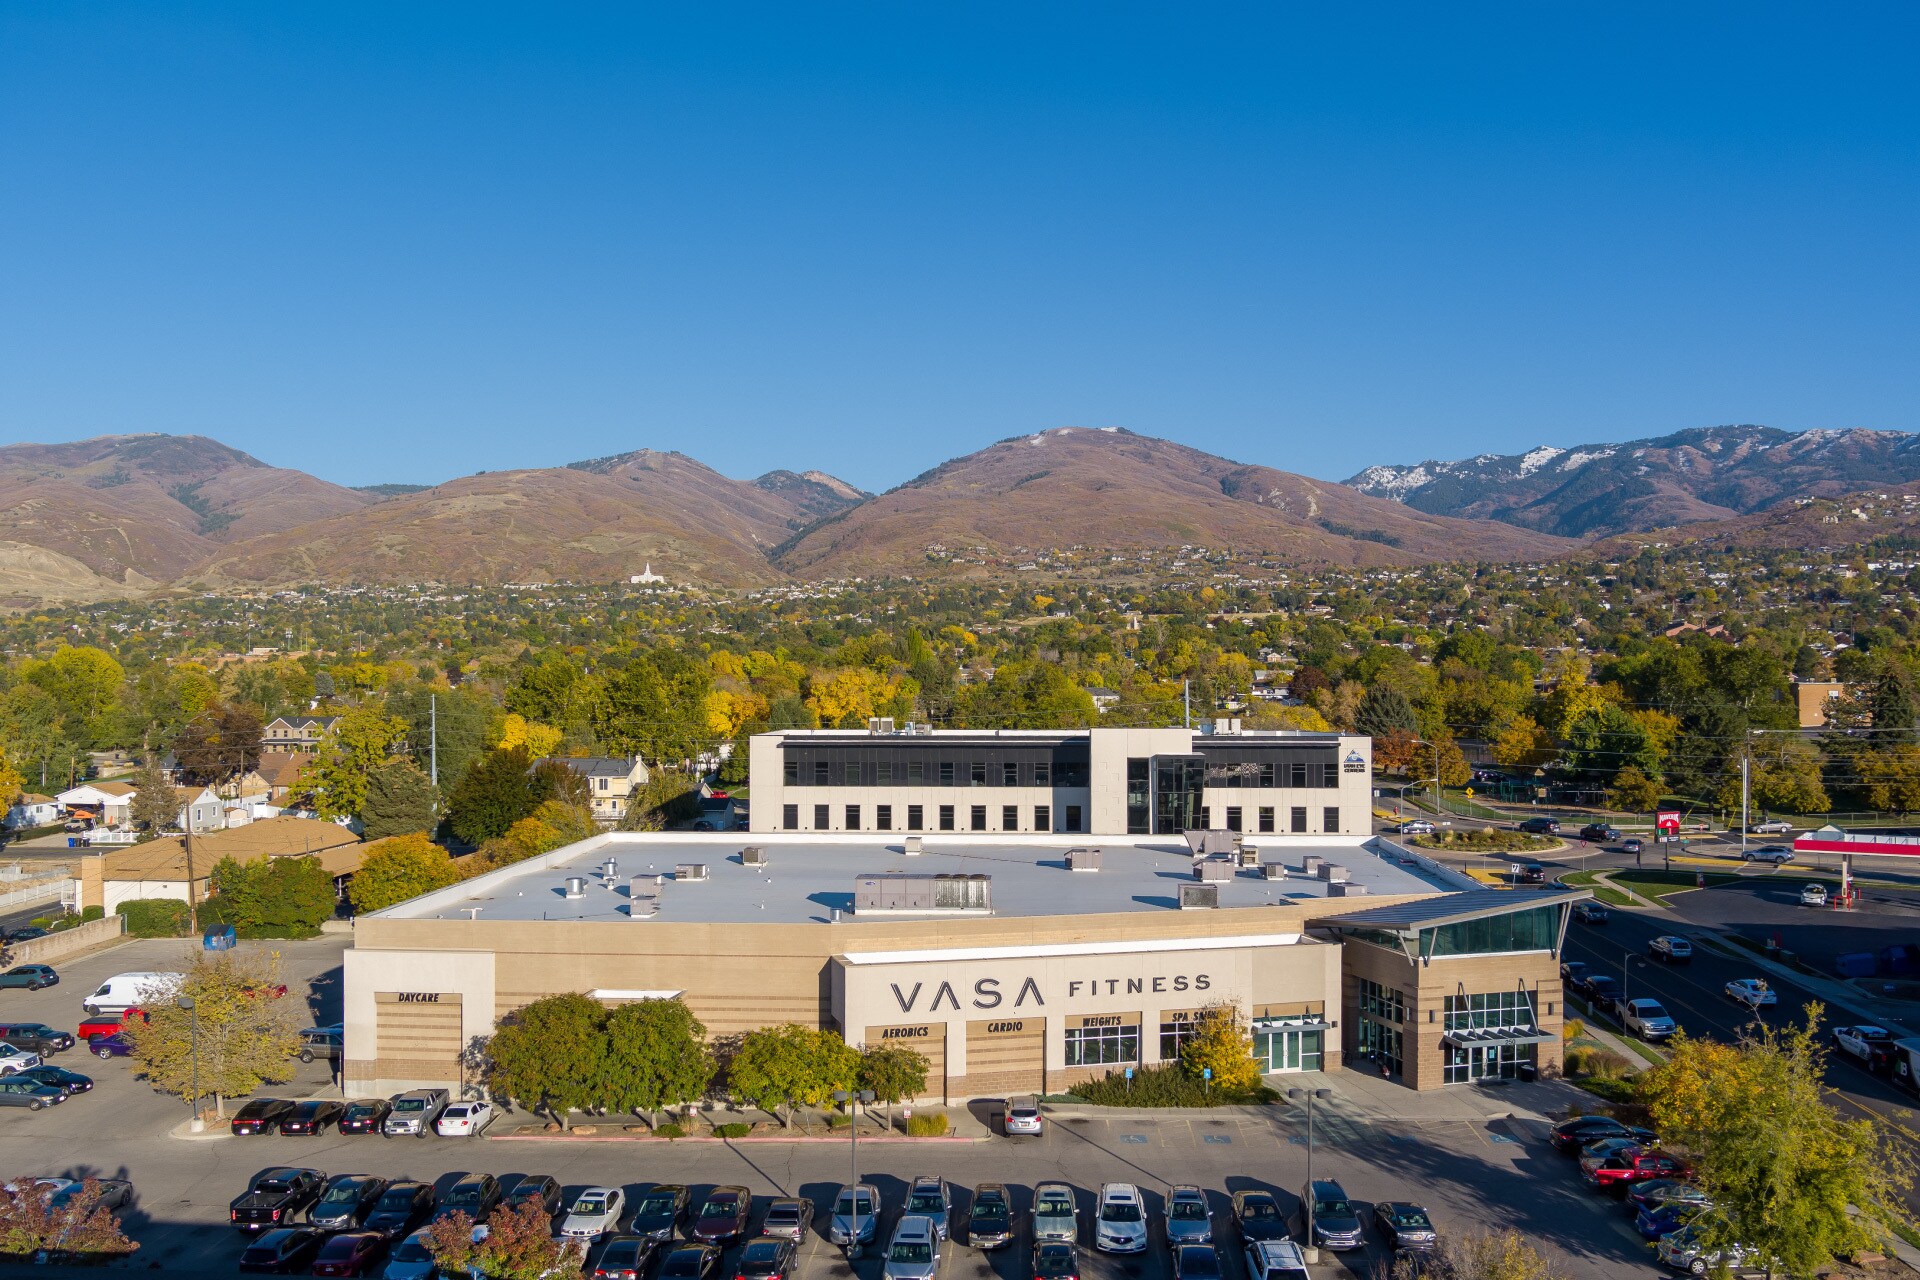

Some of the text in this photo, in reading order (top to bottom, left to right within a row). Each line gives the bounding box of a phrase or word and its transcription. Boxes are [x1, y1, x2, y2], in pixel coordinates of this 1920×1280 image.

[398, 992, 440, 1003] DAYCARE
[890, 973, 1211, 1014] VASA FITNESS
[1082, 1016, 1122, 1027] WEIGHTS
[1171, 1012, 1189, 1022] SPA
[881, 1026, 929, 1039] AEROBICS
[987, 1021, 1023, 1033] CARDIO
